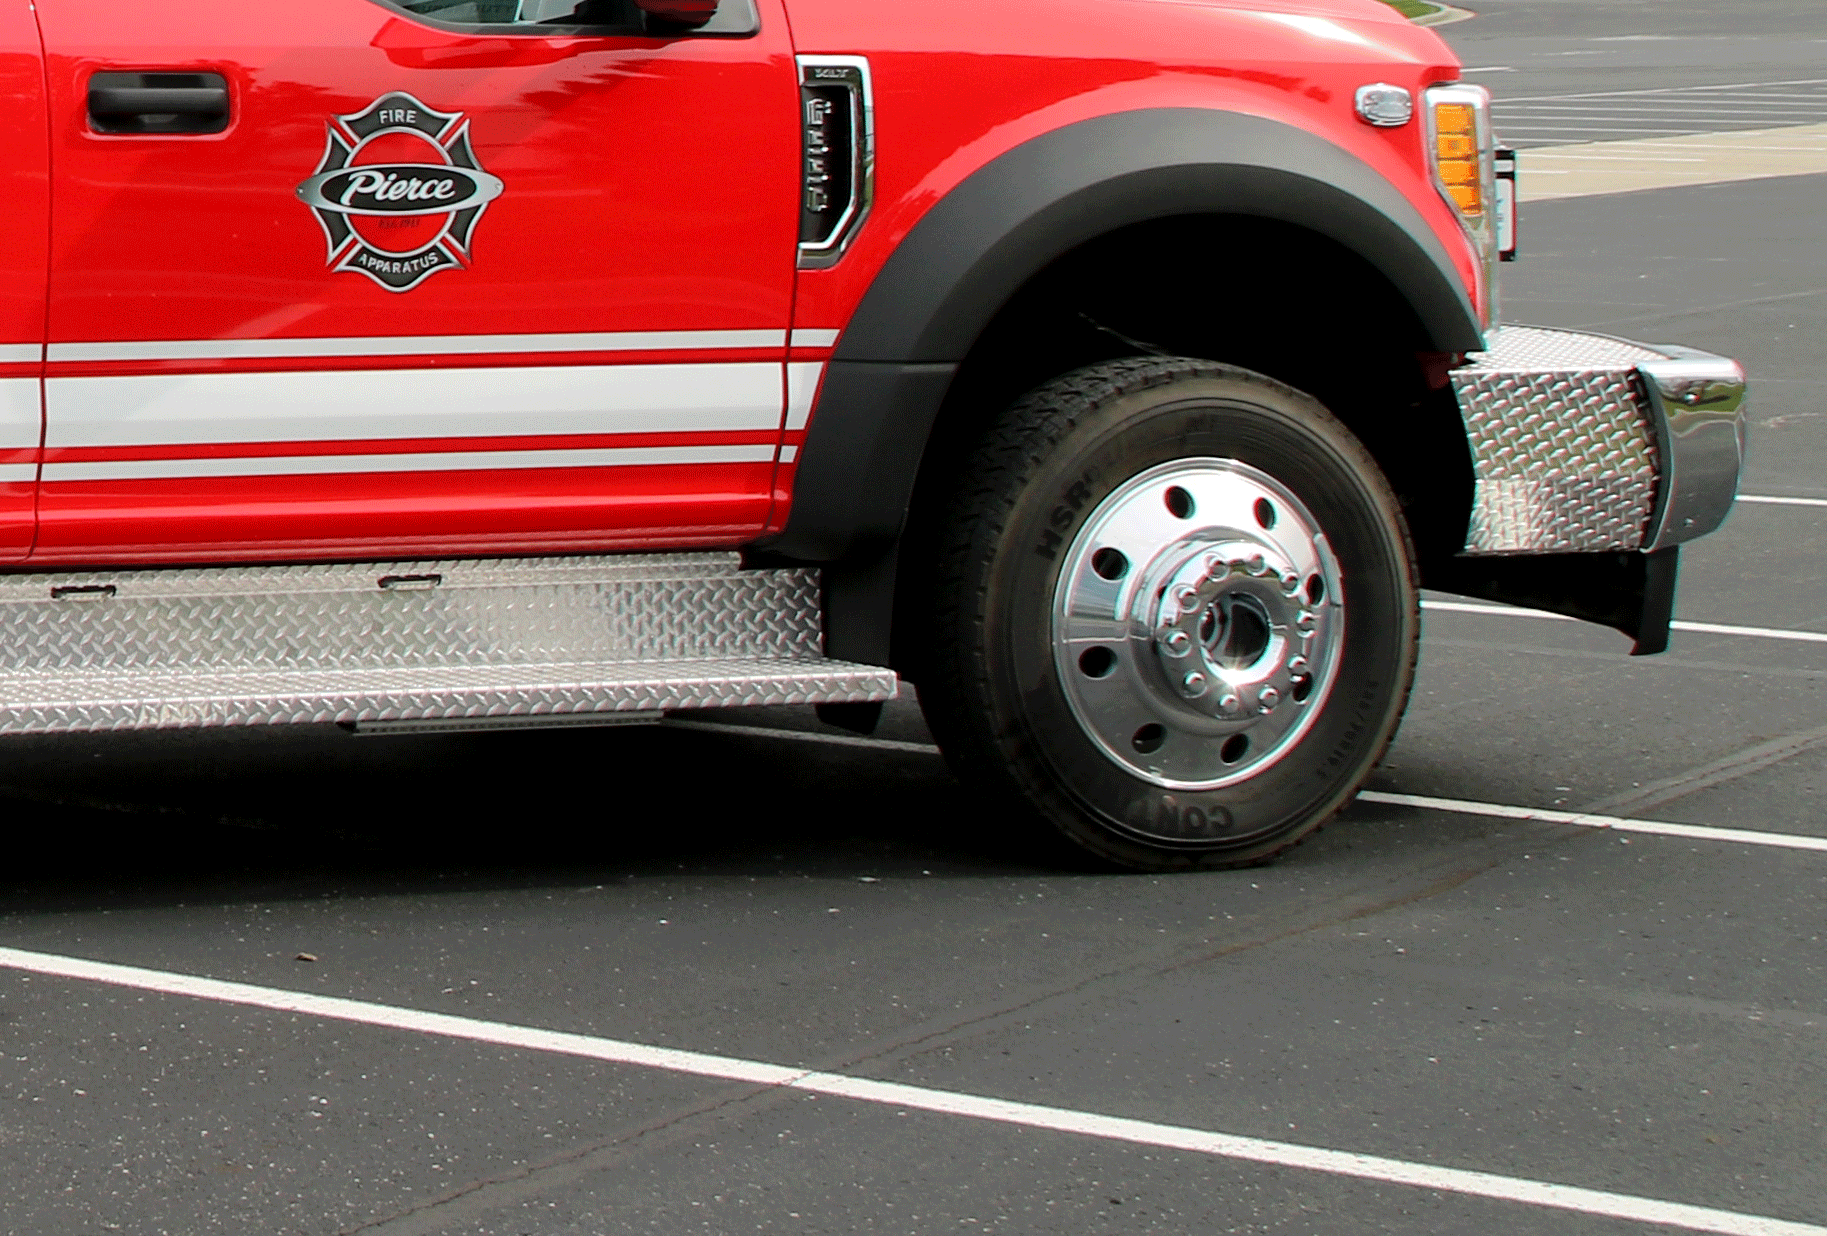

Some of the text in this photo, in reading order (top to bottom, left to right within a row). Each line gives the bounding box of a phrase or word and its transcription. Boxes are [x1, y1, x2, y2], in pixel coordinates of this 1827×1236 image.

[814, 68, 849, 78] XLT
[379, 109, 417, 124] FIRE
[340, 170, 456, 206] Pierce
[358, 252, 439, 274] APPARATUS
